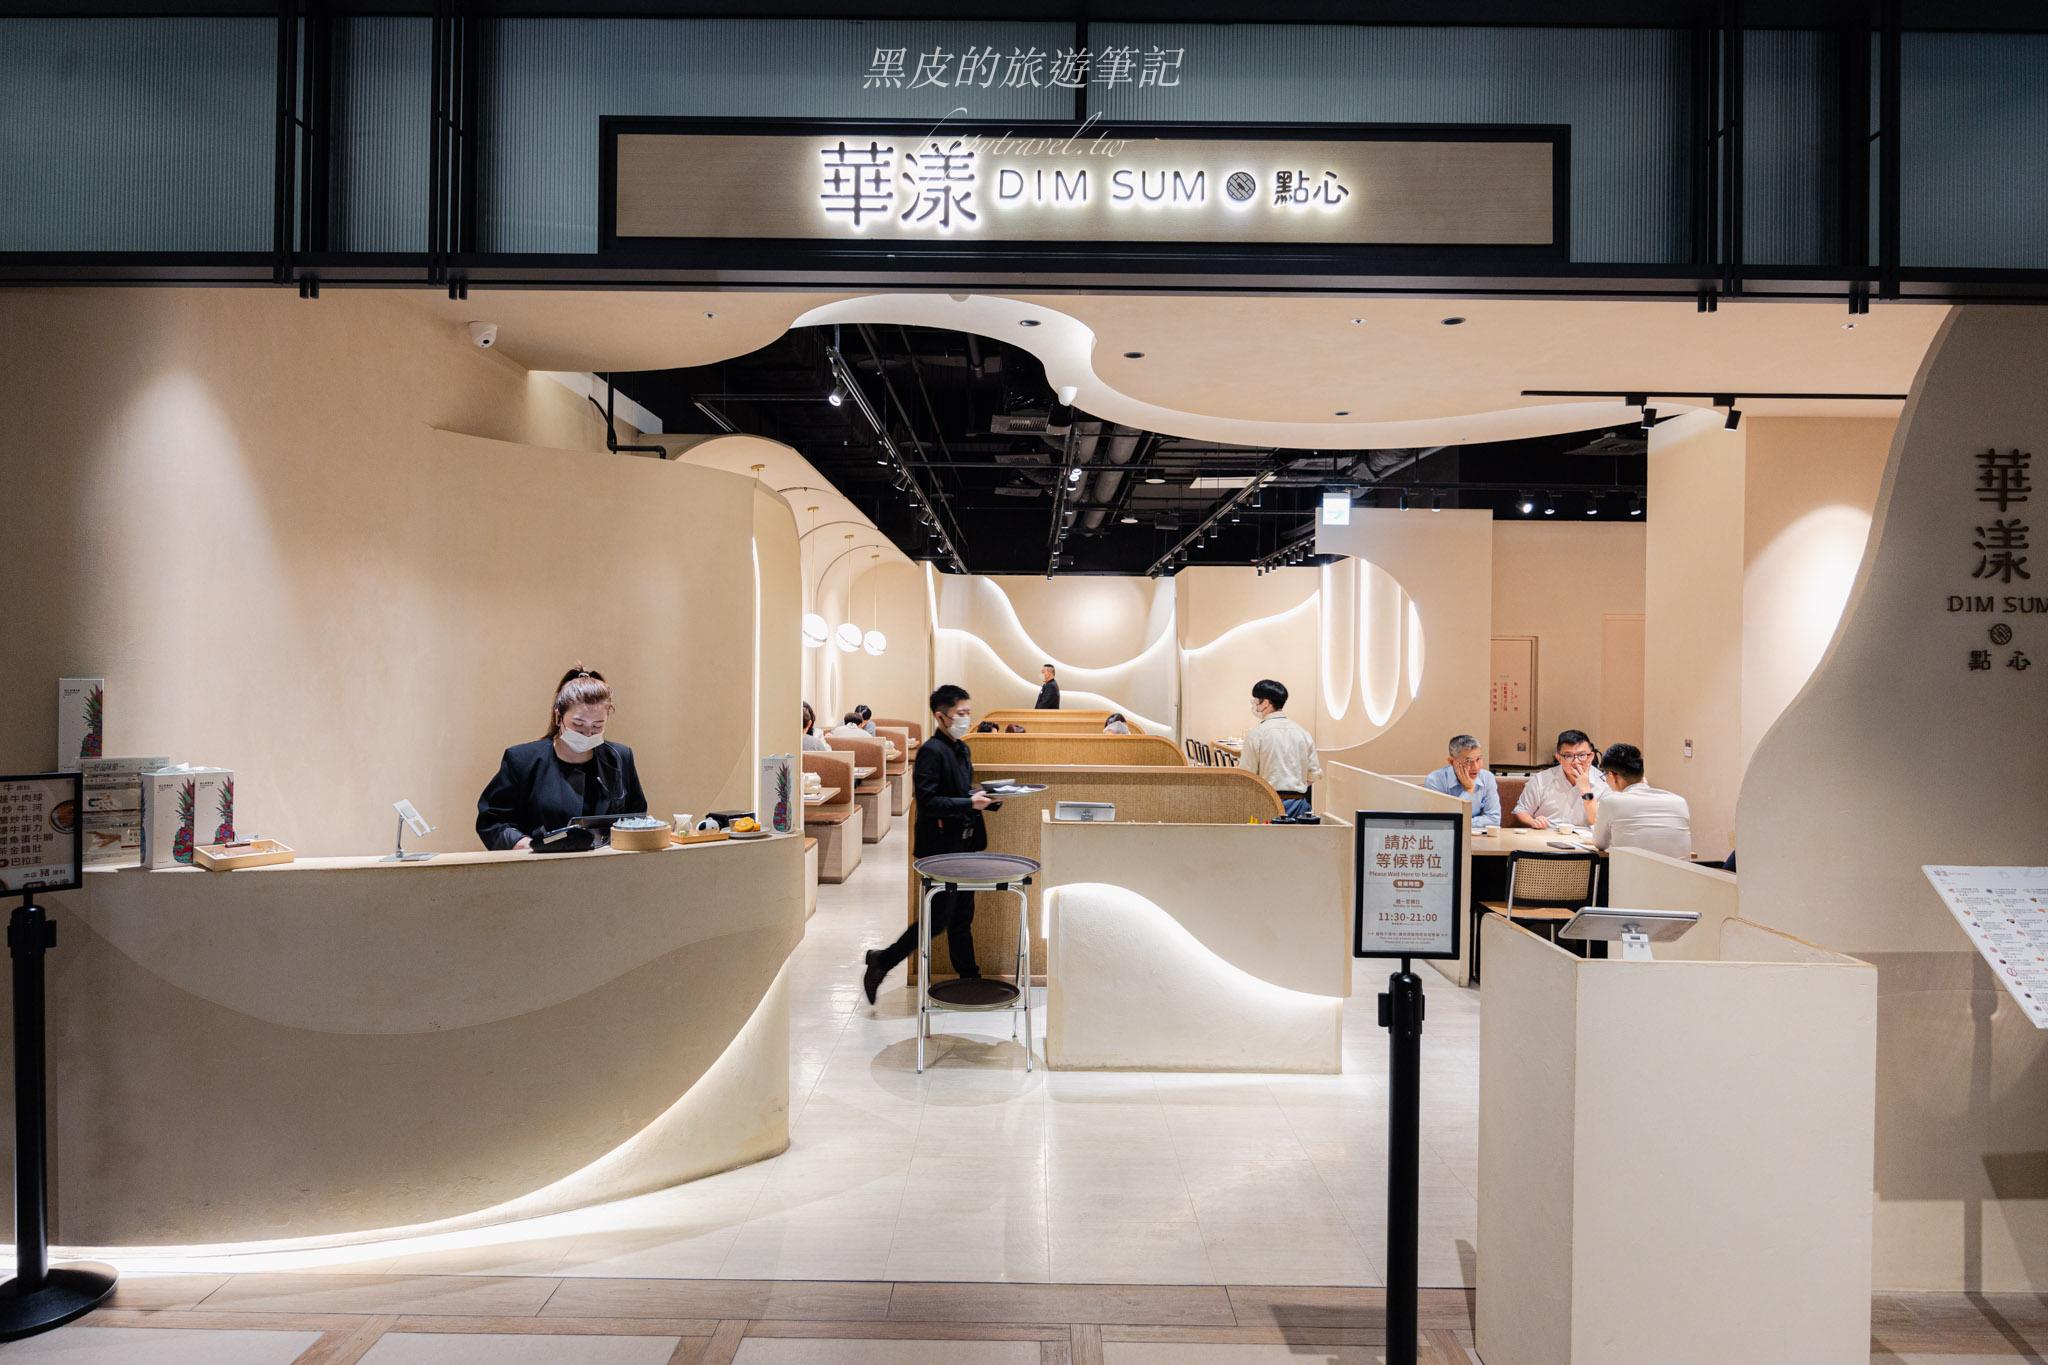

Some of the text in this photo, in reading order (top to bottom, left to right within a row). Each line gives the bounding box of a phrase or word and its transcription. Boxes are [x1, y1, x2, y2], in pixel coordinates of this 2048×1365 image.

[820, 140, 1350, 227] 華漾 DIM SUM 點心
[1972, 448, 2032, 584] 華漾
[1947, 595, 1995, 613] DIM
[1969, 649, 2032, 671] 點心
[1384, 834, 1434, 851] 請於此
[1376, 853, 1442, 869] 等候帶位
[1378, 912, 1438, 922] 11:30-21:00
